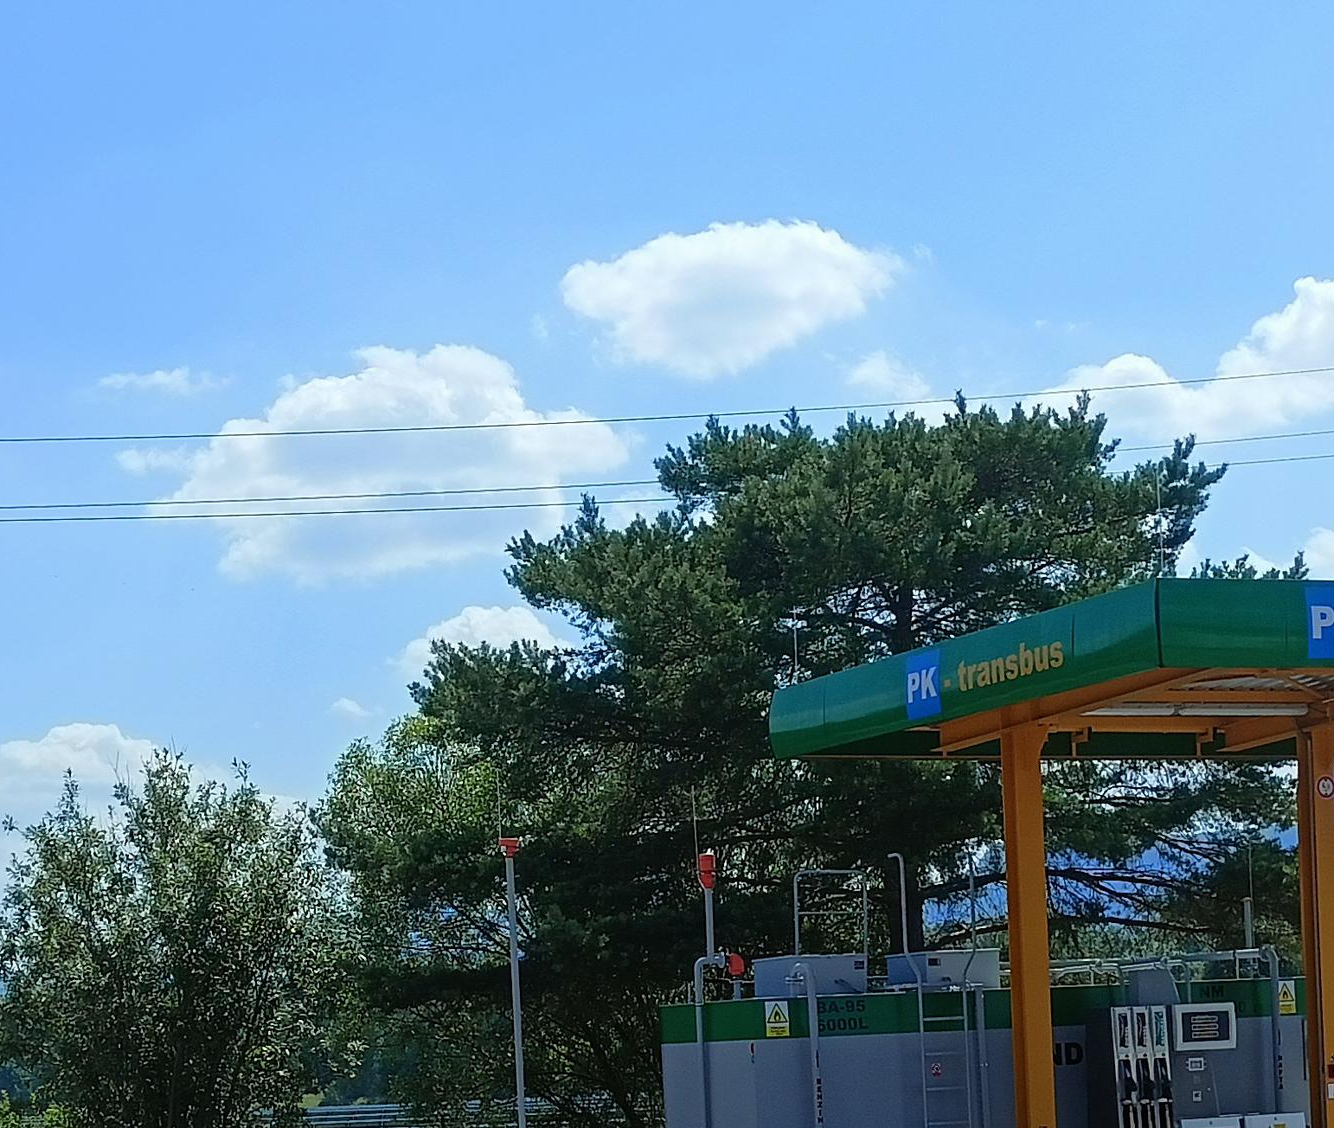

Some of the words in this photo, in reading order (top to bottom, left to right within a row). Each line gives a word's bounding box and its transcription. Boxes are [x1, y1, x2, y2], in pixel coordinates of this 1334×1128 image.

[907, 666, 937, 703] PK
[957, 641, 1064, 692] transbus
[818, 1000, 866, 1014] BA-95
[818, 1018, 868, 1031] 6000L
